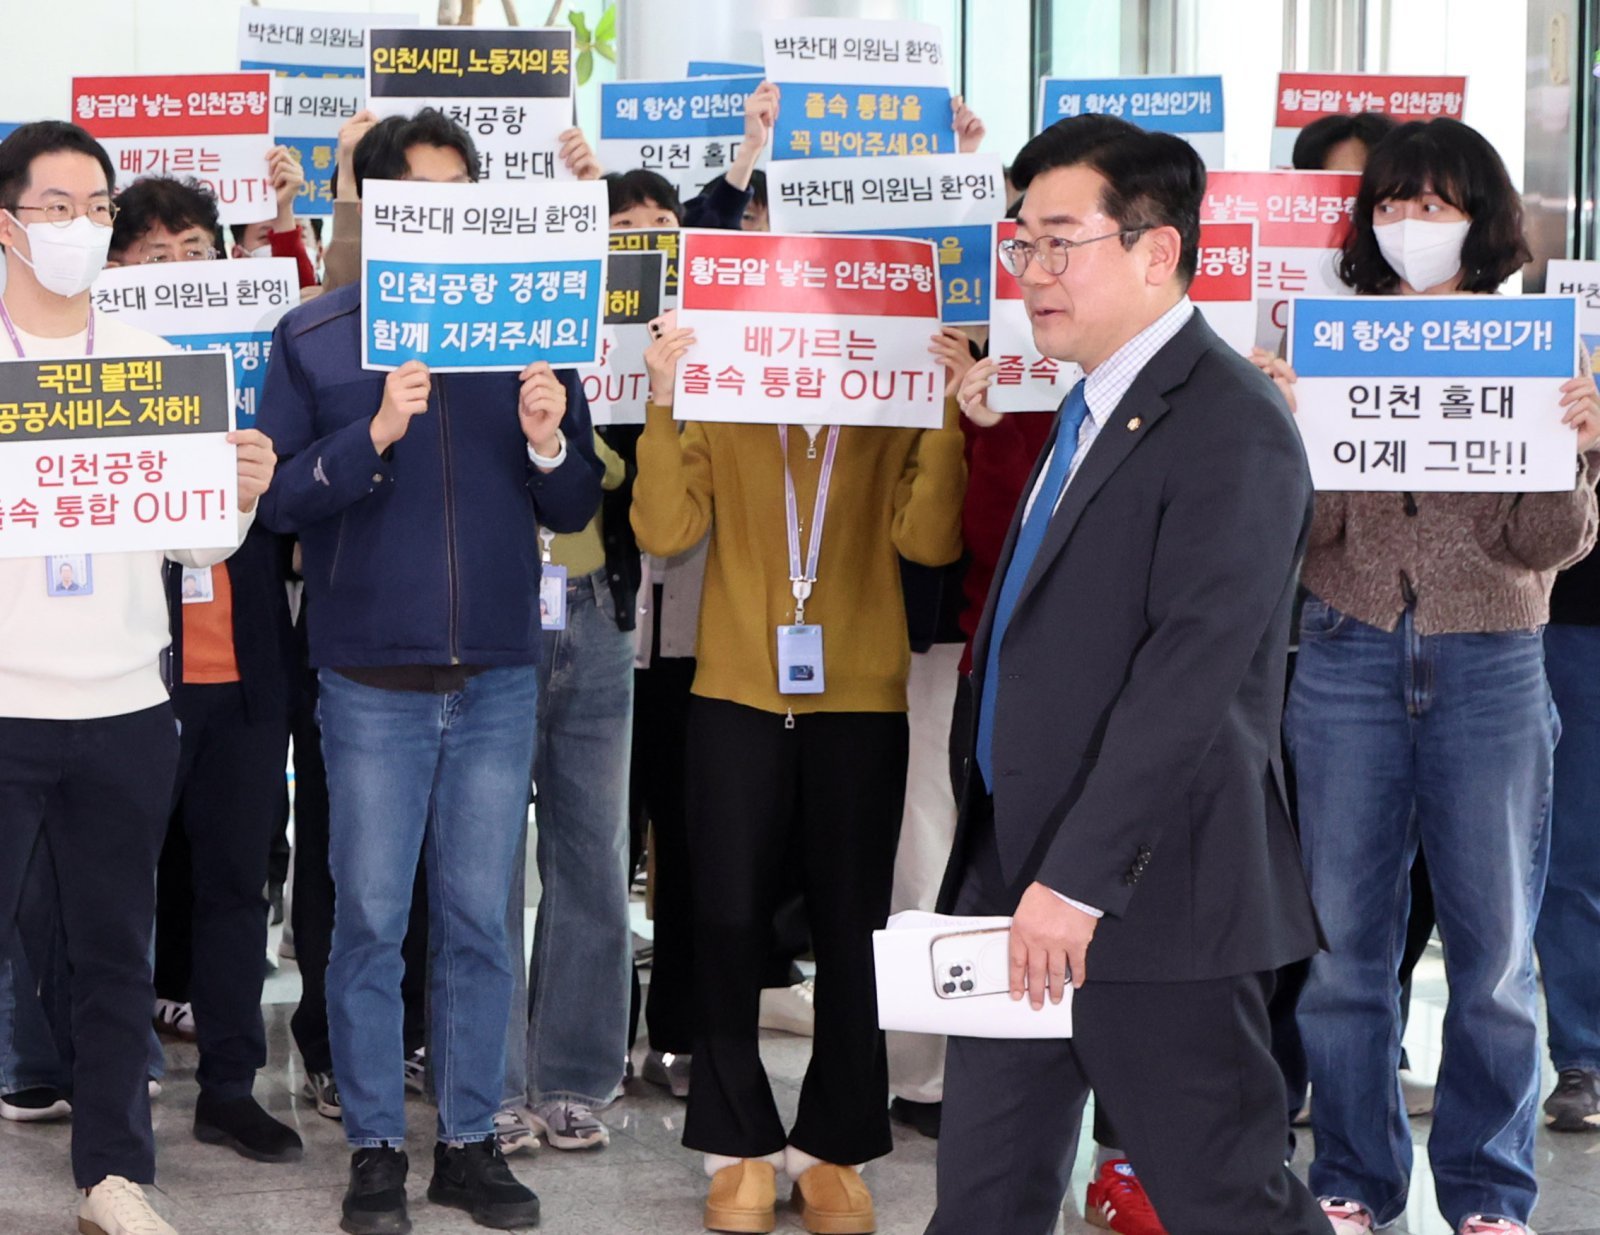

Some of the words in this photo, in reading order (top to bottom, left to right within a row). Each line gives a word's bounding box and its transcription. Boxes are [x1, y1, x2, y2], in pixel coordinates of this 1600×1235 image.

[248, 22, 303, 45] 박찬대
[309, 27, 365, 48] 의원님
[775, 37, 837, 60] 박찬대
[843, 38, 899, 62] 의원님
[372, 48, 463, 77] 인천시민,
[467, 48, 547, 76] 노동자의
[551, 49, 570, 75] 뜻
[76, 94, 138, 119] 황금알
[143, 93, 182, 117] 낳는
[186, 90, 267, 117] 인천공항
[298, 96, 358, 118] 의원님
[616, 98, 638, 121] 왜
[643, 97, 686, 121] 항상
[690, 92, 753, 119] 인천인
[805, 92, 848, 119] 졸속
[857, 93, 922, 122] 통합을
[1058, 94, 1081, 116] 왜
[1085, 92, 1127, 117] 항상
[1130, 91, 1211, 116] 인천인가!
[1281, 88, 1342, 111] 황금알
[1346, 90, 1386, 112] 낳는
[1389, 91, 1462, 115] 인천공항
[440, 105, 527, 136] 천공항
[640, 143, 691, 170] 인천
[790, 130, 811, 157] 꼭
[119, 148, 222, 175] 배가르는
[505, 151, 554, 180] 반대
[780, 180, 854, 207] 박찬대
[862, 177, 933, 203] 의원님
[939, 173, 997, 201] 환영!
[374, 205, 454, 235] 박찬대
[462, 206, 537, 235] 의원님
[544, 204, 597, 233] 환영!
[1208, 194, 1259, 222] 낳는
[689, 256, 770, 287] 황금알
[775, 258, 829, 288] 낳는
[834, 260, 934, 294] 인천공항
[1195, 245, 1250, 277] 공항
[90, 284, 147, 314] 찬대
[154, 281, 229, 310] 의원님
[236, 277, 290, 306] 환영!
[378, 270, 498, 305] 인천공항
[508, 270, 588, 303] 경쟁력
[372, 318, 429, 353] 함께
[440, 317, 589, 353] 지켜주세요!
[743, 325, 877, 361] 배가르는
[1313, 320, 1345, 351] 왜
[1352, 319, 1414, 352] 항상
[1421, 319, 1553, 352] 인천인가!
[37, 362, 92, 395] 국민
[99, 360, 163, 392] 불편!
[682, 363, 746, 397] 졸속
[760, 366, 827, 399] 통합
[840, 369, 935, 403] OUT!
[997, 354, 1060, 387] 졸속
[0, 400, 131, 435] 공공서비스
[138, 394, 201, 427] 저하!
[1347, 384, 1422, 420] 인천
[1439, 384, 1514, 420] 홀대
[35, 450, 168, 488] 인천공항
[1333, 440, 1407, 475] 이제
[1423, 440, 1527, 476] 그만!!
[0, 496, 40, 531] 속
[53, 492, 120, 529] 통합
[133, 488, 226, 525] OUT!
